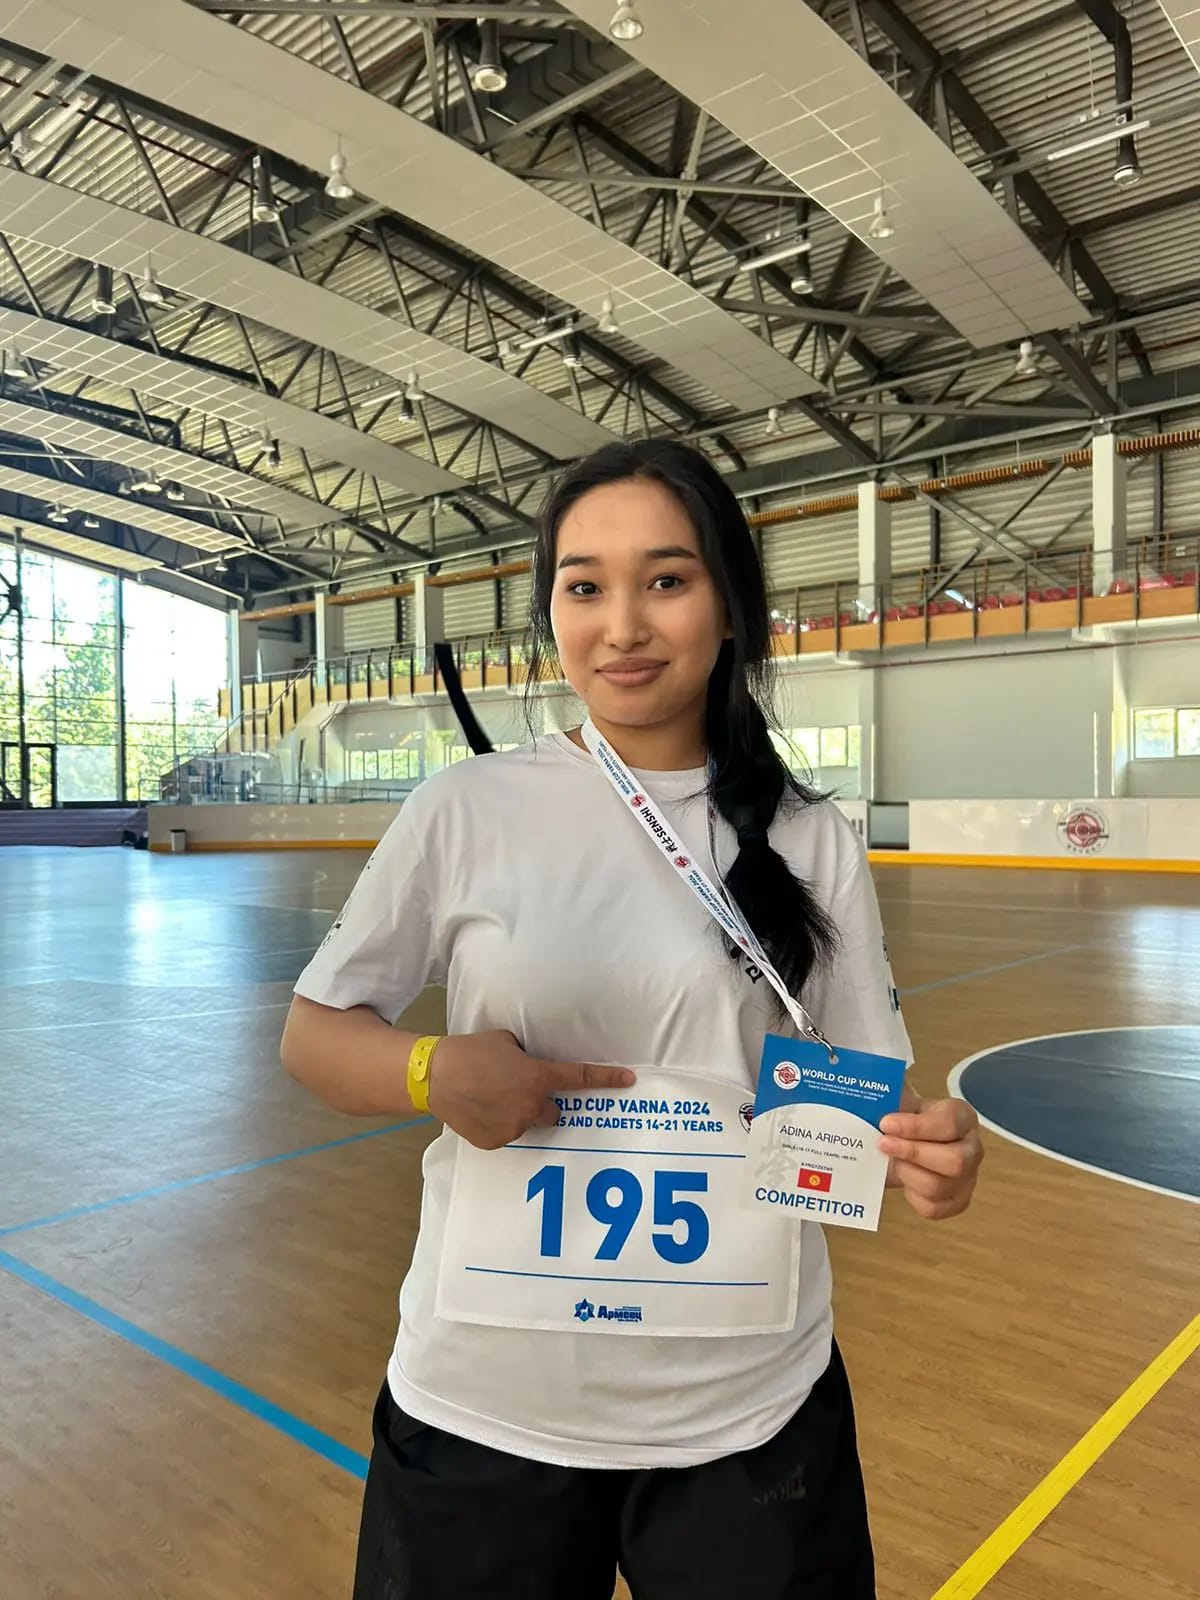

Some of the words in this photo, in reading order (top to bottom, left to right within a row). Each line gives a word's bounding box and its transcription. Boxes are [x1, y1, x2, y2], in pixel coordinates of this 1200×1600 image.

[640, 806, 667, 837] SENSHI
[802, 1068, 835, 1081] WORLD
[837, 1075, 857, 1085] CUP
[859, 1080, 890, 1093] VARNA
[585, 1098, 615, 1112] CUP
[619, 1099, 669, 1113] VARNA
[673, 1101, 710, 1115] 2024
[568, 1116, 593, 1127] AND
[596, 1117, 643, 1129] CADETS
[646, 1119, 678, 1131] 14-21
[682, 1120, 723, 1132] YEARS
[780, 1125, 812, 1139] ADINA
[815, 1132, 864, 1149] ARIPOVA
[526, 1165, 709, 1264] 195
[755, 1187, 865, 1218] COMPETITOR
